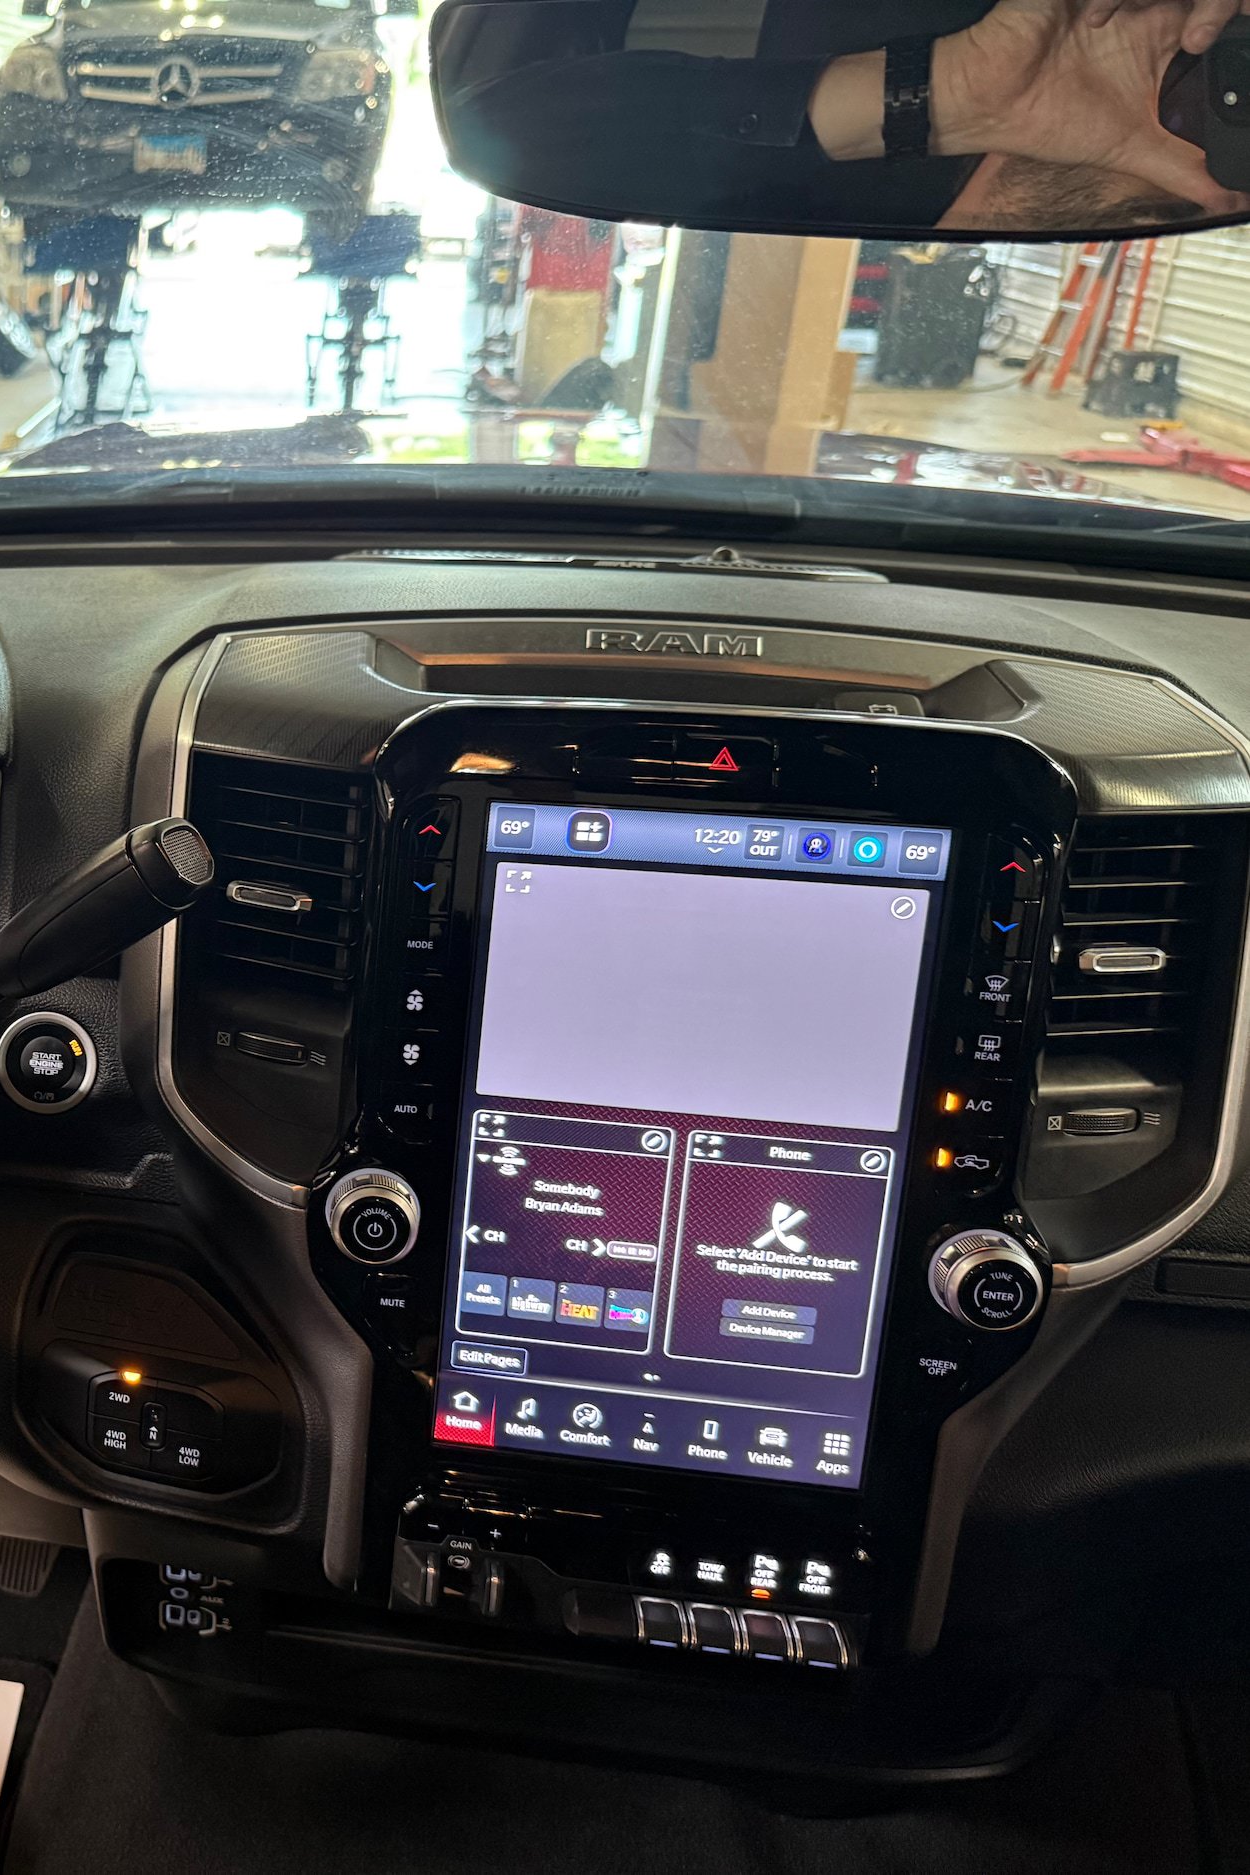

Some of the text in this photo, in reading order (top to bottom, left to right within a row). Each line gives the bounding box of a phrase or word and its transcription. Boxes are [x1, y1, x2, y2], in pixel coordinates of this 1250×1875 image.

[585, 628, 764, 657] RAM
[501, 820, 530, 835] 69°
[694, 828, 741, 845] 12:20
[753, 829, 780, 843] 79°
[750, 844, 779, 857] OUT
[905, 845, 937, 861] 69°
[407, 940, 434, 950] MODE
[979, 992, 1012, 1003] FRONT
[32, 1052, 61, 1061] START
[974, 1051, 1000, 1062] REAR
[29, 1060, 64, 1070] ENGINE
[33, 1067, 58, 1075] STOP
[394, 1104, 418, 1114] AUTO
[965, 1099, 992, 1113] A/C
[769, 1146, 812, 1162] Phone
[533, 1180, 601, 1200] Somebody
[524, 1197, 605, 1216] Bryan Adams
[361, 1207, 392, 1220] VOLUME
[483, 1229, 506, 1243] CH
[565, 1238, 588, 1252] CH
[696, 1244, 735, 1258] Select
[813, 1255, 827, 1268] to
[827, 1257, 859, 1272] start
[716, 1259, 835, 1282] the pairing process.
[990, 1272, 1014, 1283] TUNE
[559, 1284, 569, 1294] 2
[608, 1290, 618, 1300] 3
[465, 1292, 502, 1305] Presets
[982, 1290, 1015, 1302] ENTER
[380, 1298, 406, 1308] MUTE
[560, 1303, 600, 1320] HEAT
[741, 1305, 798, 1320] Add Device
[981, 1306, 1013, 1319] SCROLL
[729, 1323, 806, 1340] Device Manager
[459, 1349, 522, 1369] Edit Pages
[919, 1357, 957, 1370] SCREEN
[928, 1367, 947, 1376] OFF
[109, 1392, 131, 1404] 2WD
[445, 1415, 483, 1432] Home
[105, 1429, 127, 1441] 4WD
[505, 1422, 545, 1440] Media
[104, 1439, 127, 1450] HIGH
[560, 1429, 612, 1447] Comfort
[179, 1446, 200, 1458] 4WD
[633, 1438, 661, 1453] Nav
[687, 1444, 729, 1460] Phone
[179, 1455, 200, 1467] LOW
[748, 1451, 794, 1468] Vehicle
[816, 1459, 850, 1476] Apps
[450, 1540, 472, 1550] GAIN
[650, 1564, 671, 1575] OFF
[754, 1569, 776, 1580] OFF
[750, 1577, 778, 1588] REAR
[806, 1575, 827, 1585] OFF
[798, 1583, 832, 1595] FRONT
